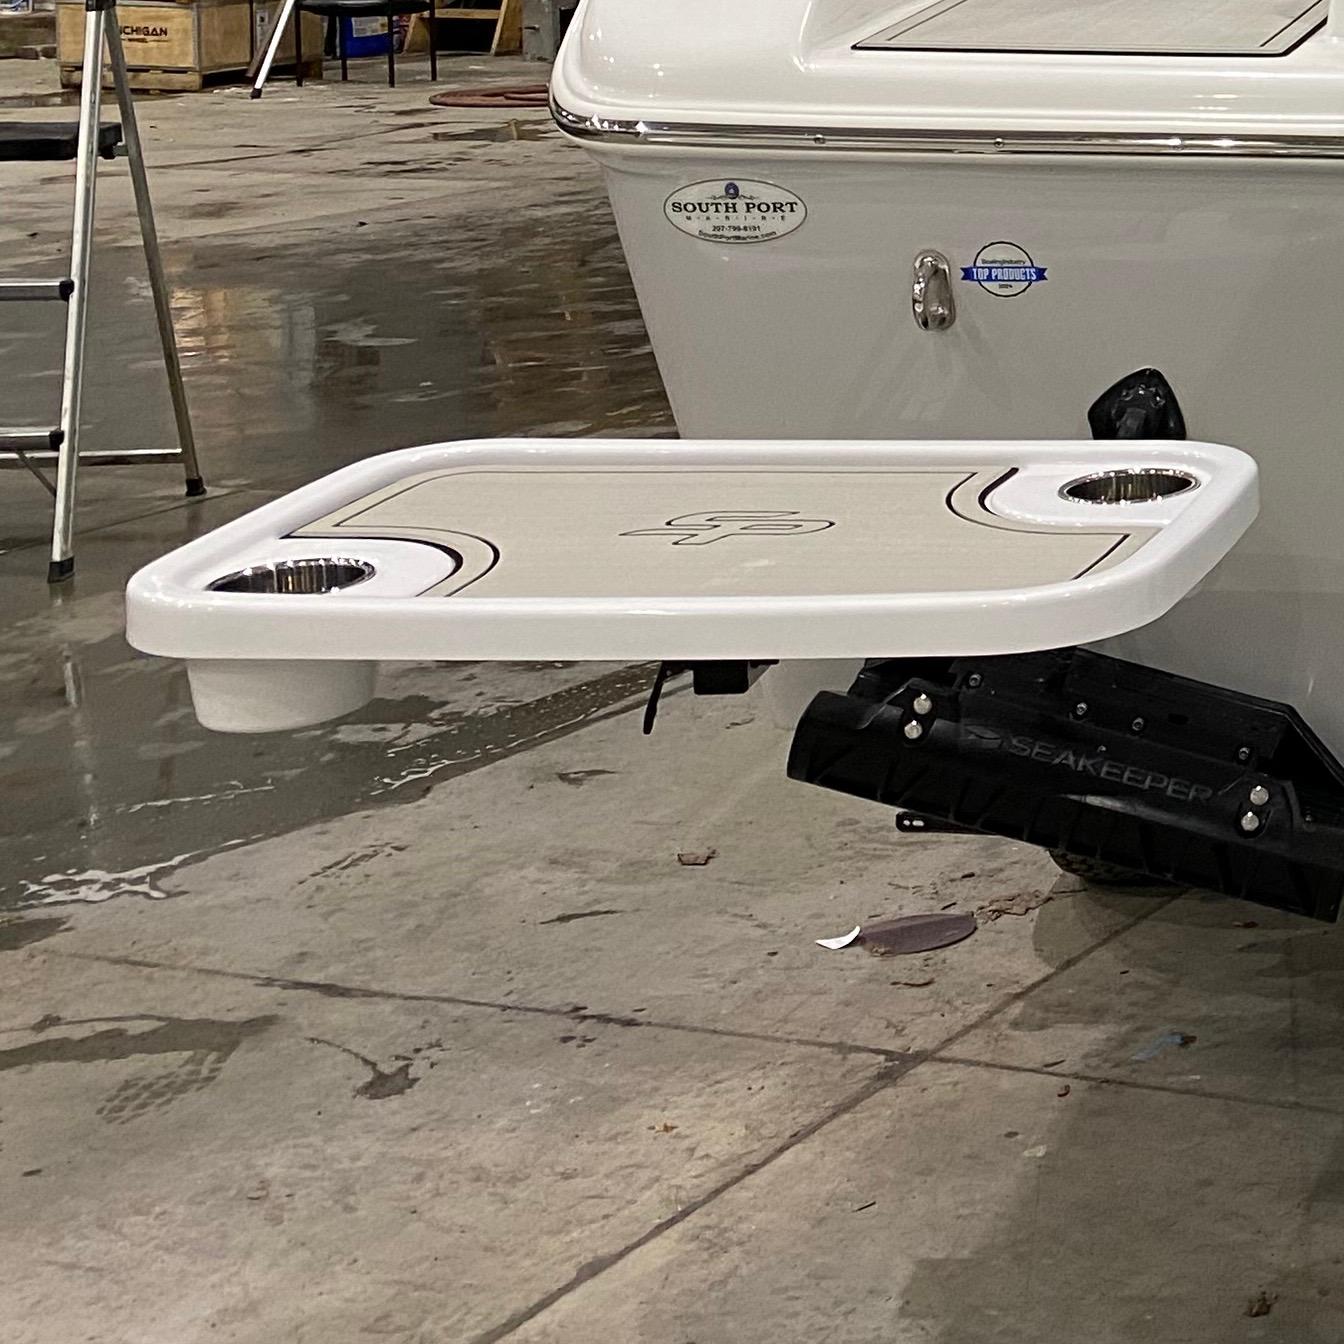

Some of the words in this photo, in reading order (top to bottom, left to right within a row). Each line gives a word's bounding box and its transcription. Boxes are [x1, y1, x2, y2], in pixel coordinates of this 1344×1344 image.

[671, 201, 738, 213] SOUTH
[745, 201, 798, 213] PORT
[972, 268, 989, 280] TOP
[991, 268, 1037, 281] PRODUCTS
[1008, 736, 1213, 802] SEAKEEPER
